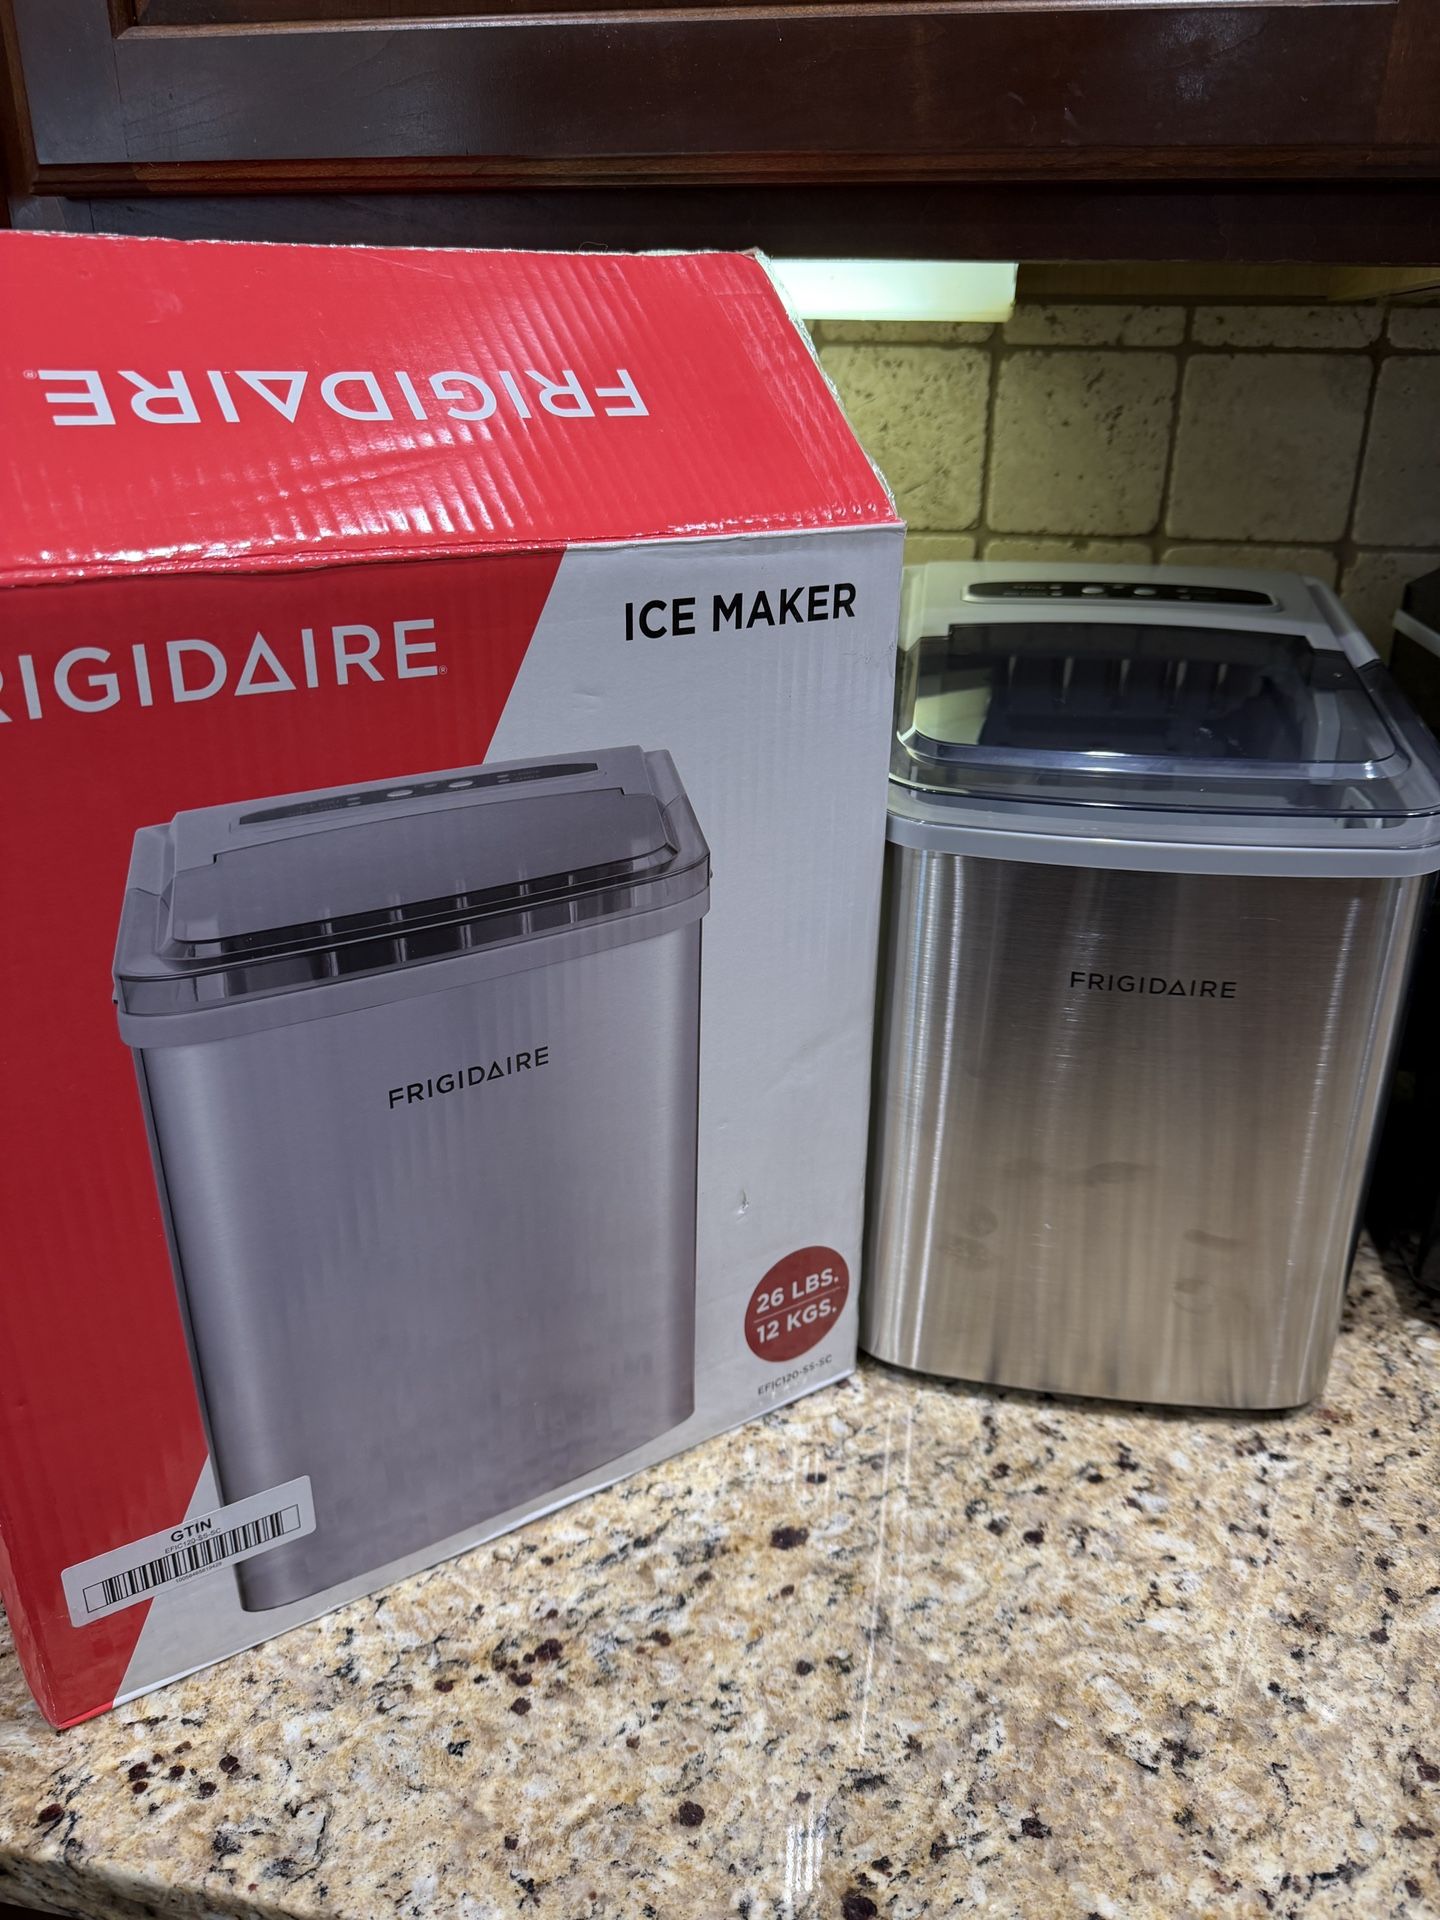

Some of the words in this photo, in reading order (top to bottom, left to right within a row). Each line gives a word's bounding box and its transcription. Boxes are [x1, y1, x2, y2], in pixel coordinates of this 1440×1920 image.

[38, 369, 650, 426] FRIGIDAIRE
[625, 597, 696, 641] ICE
[713, 582, 857, 632] MAKER
[0, 618, 438, 724] IGIDAIRE
[1070, 971, 1238, 999] FRIGIDAIRE
[388, 1046, 549, 1109] FRIGIDAIRE
[756, 1287, 785, 1314] 26
[792, 1268, 839, 1300] LBS.
[757, 1320, 780, 1344] 12
[787, 1298, 837, 1332] KGS.
[758, 1354, 833, 1395] EFIC120-SS-SC
[170, 1518, 212, 1542] GTIN
